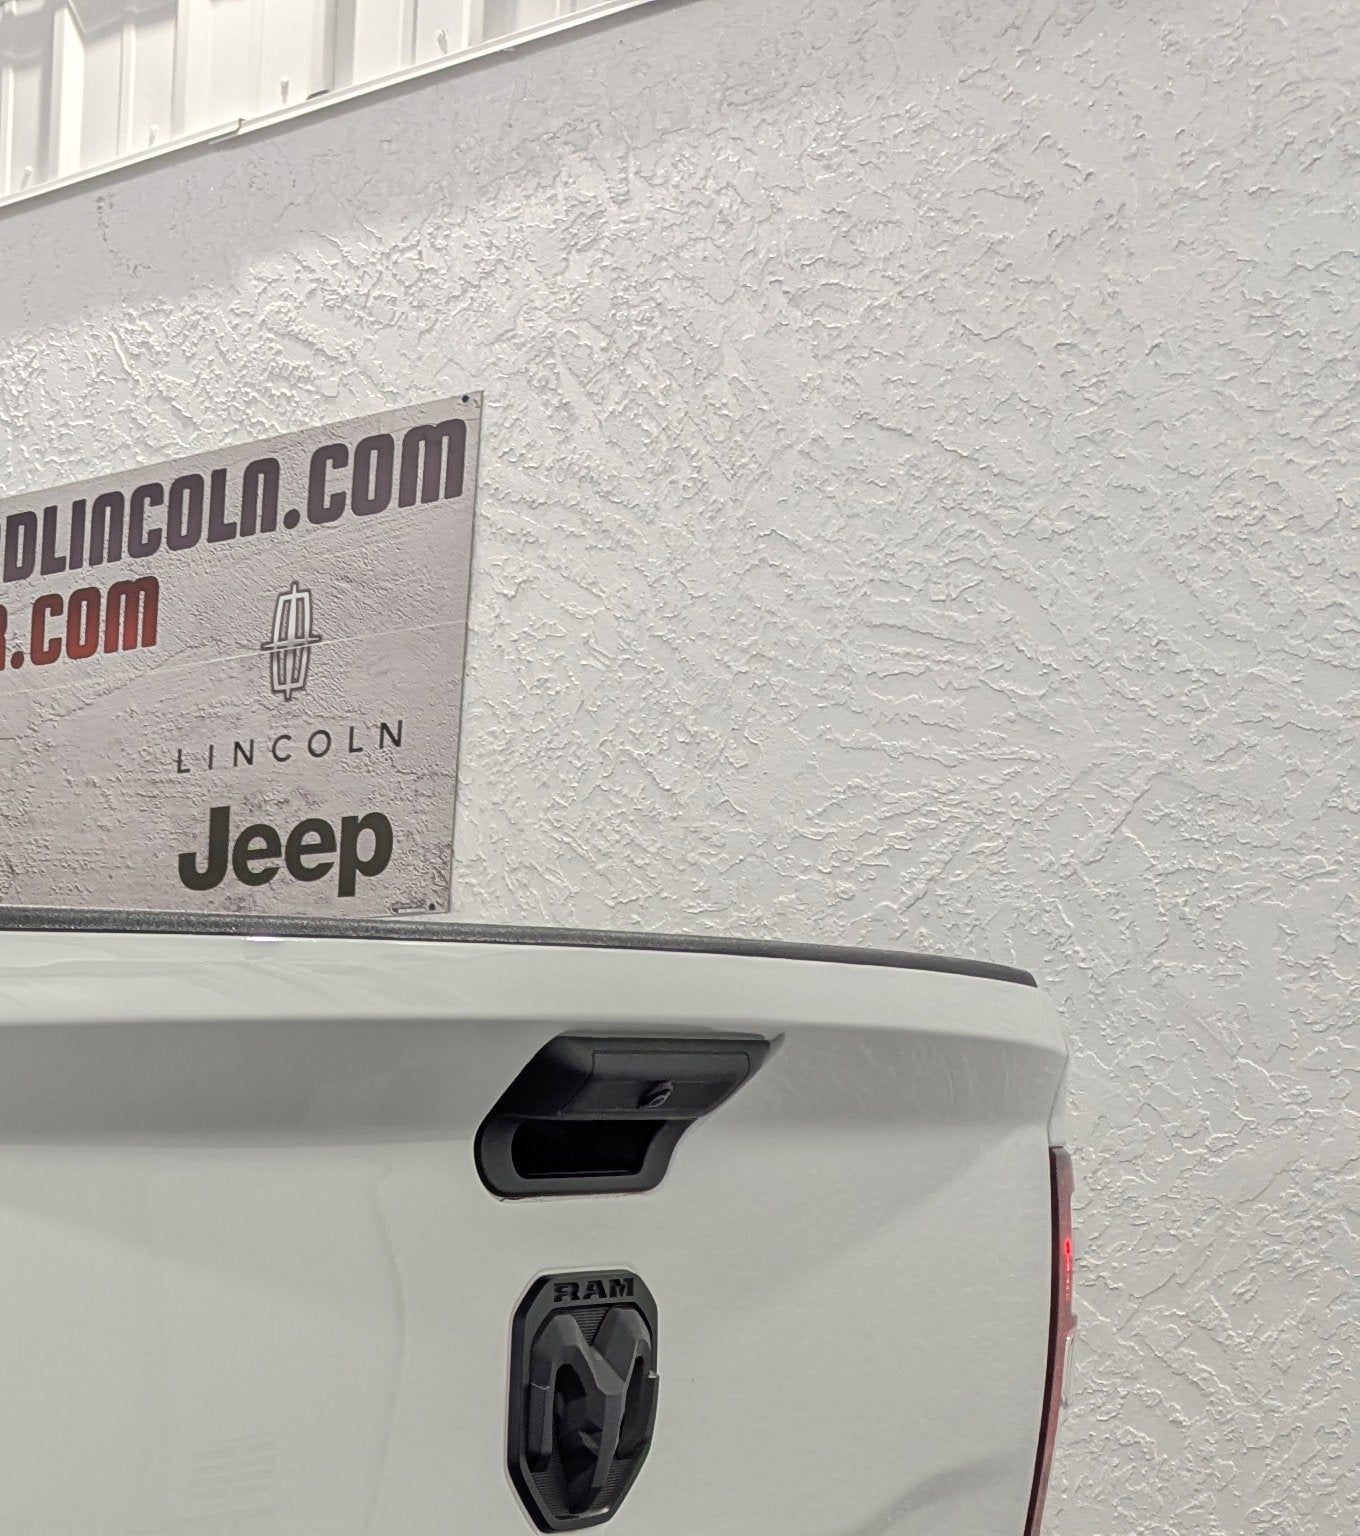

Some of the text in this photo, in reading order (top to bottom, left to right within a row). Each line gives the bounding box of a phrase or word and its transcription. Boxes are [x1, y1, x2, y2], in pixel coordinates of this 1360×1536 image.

[177, 720, 403, 774] LINCOLN
[178, 806, 394, 897] Jeep
[553, 1277, 635, 1303] RAM
